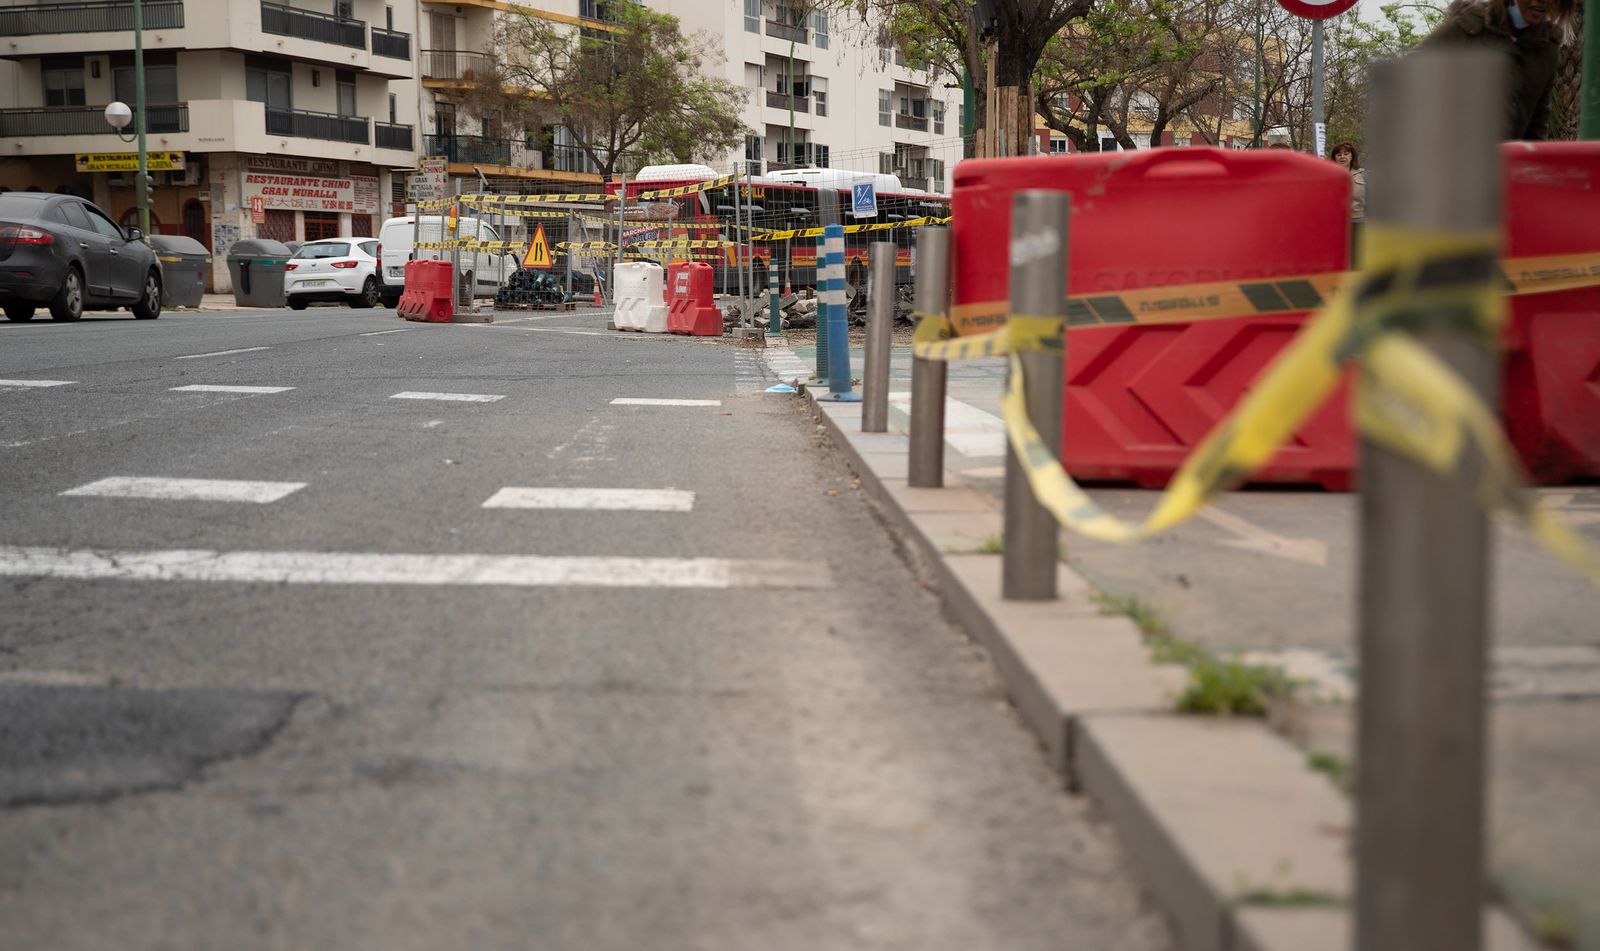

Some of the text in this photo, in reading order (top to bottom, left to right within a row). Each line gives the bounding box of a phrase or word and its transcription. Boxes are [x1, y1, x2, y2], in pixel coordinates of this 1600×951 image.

[146, 152, 166, 160] HINO
[248, 156, 337, 173] RESTAURANTE CHINO
[245, 174, 351, 190] RESTAURANTE CHINO
[261, 186, 337, 199] GRAN MURALLA
[741, 186, 765, 198] SEILLA
